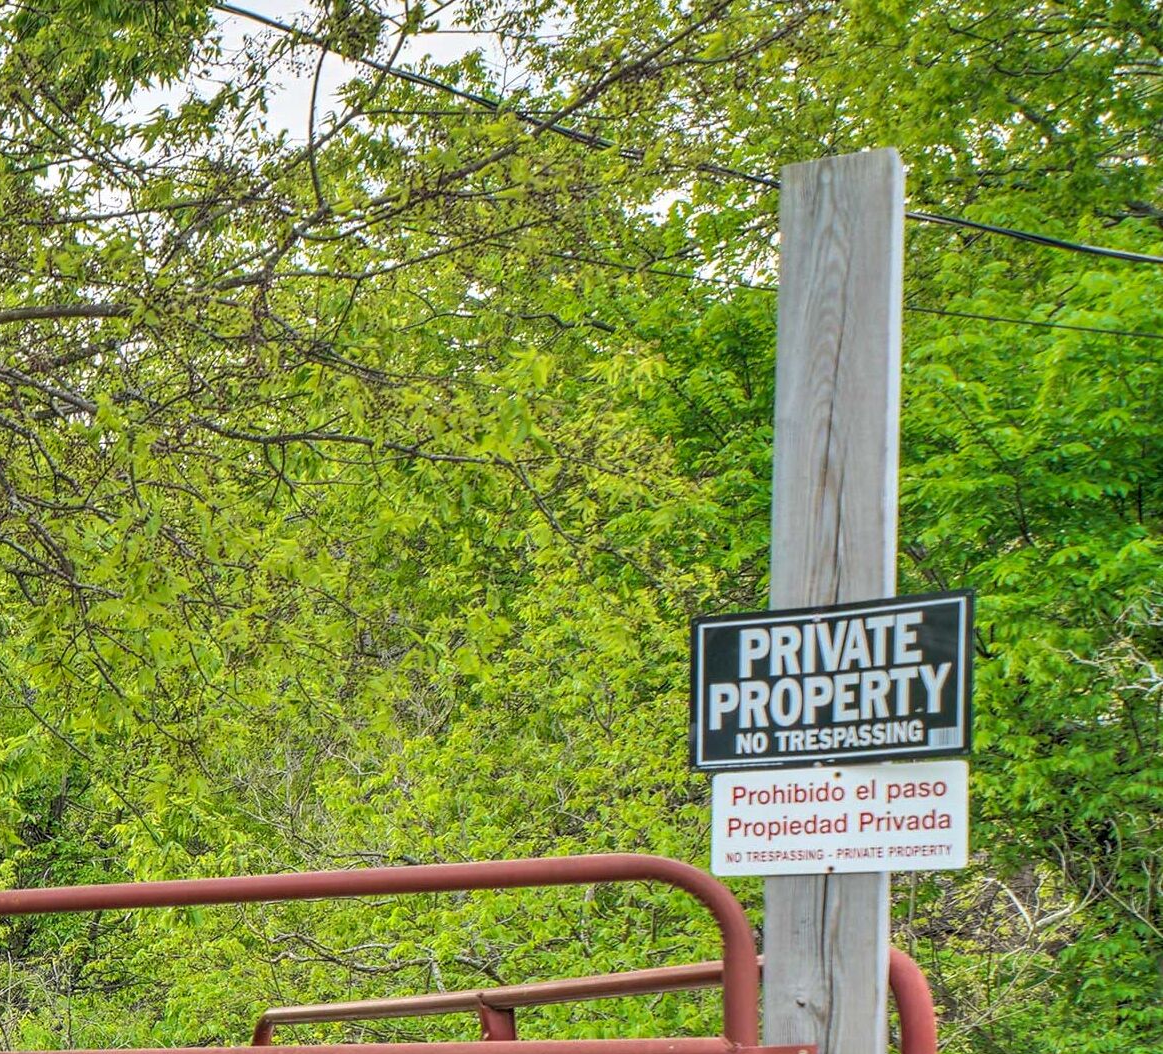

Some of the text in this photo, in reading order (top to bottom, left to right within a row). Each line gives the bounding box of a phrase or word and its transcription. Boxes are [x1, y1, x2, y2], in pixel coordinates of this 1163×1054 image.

[739, 611, 924, 679] PRIVATE
[709, 662, 952, 731] PROPERTY
[735, 720, 924, 755] NO TRESPASSING
[732, 779, 947, 806] Prohibido el paso
[726, 810, 952, 841] Propiedad Privada
[725, 851, 742, 863] NO
[746, 849, 825, 863] TRESPASSING
[836, 846, 885, 860] PRIVATE
[889, 844, 954, 858] PROPERTY
